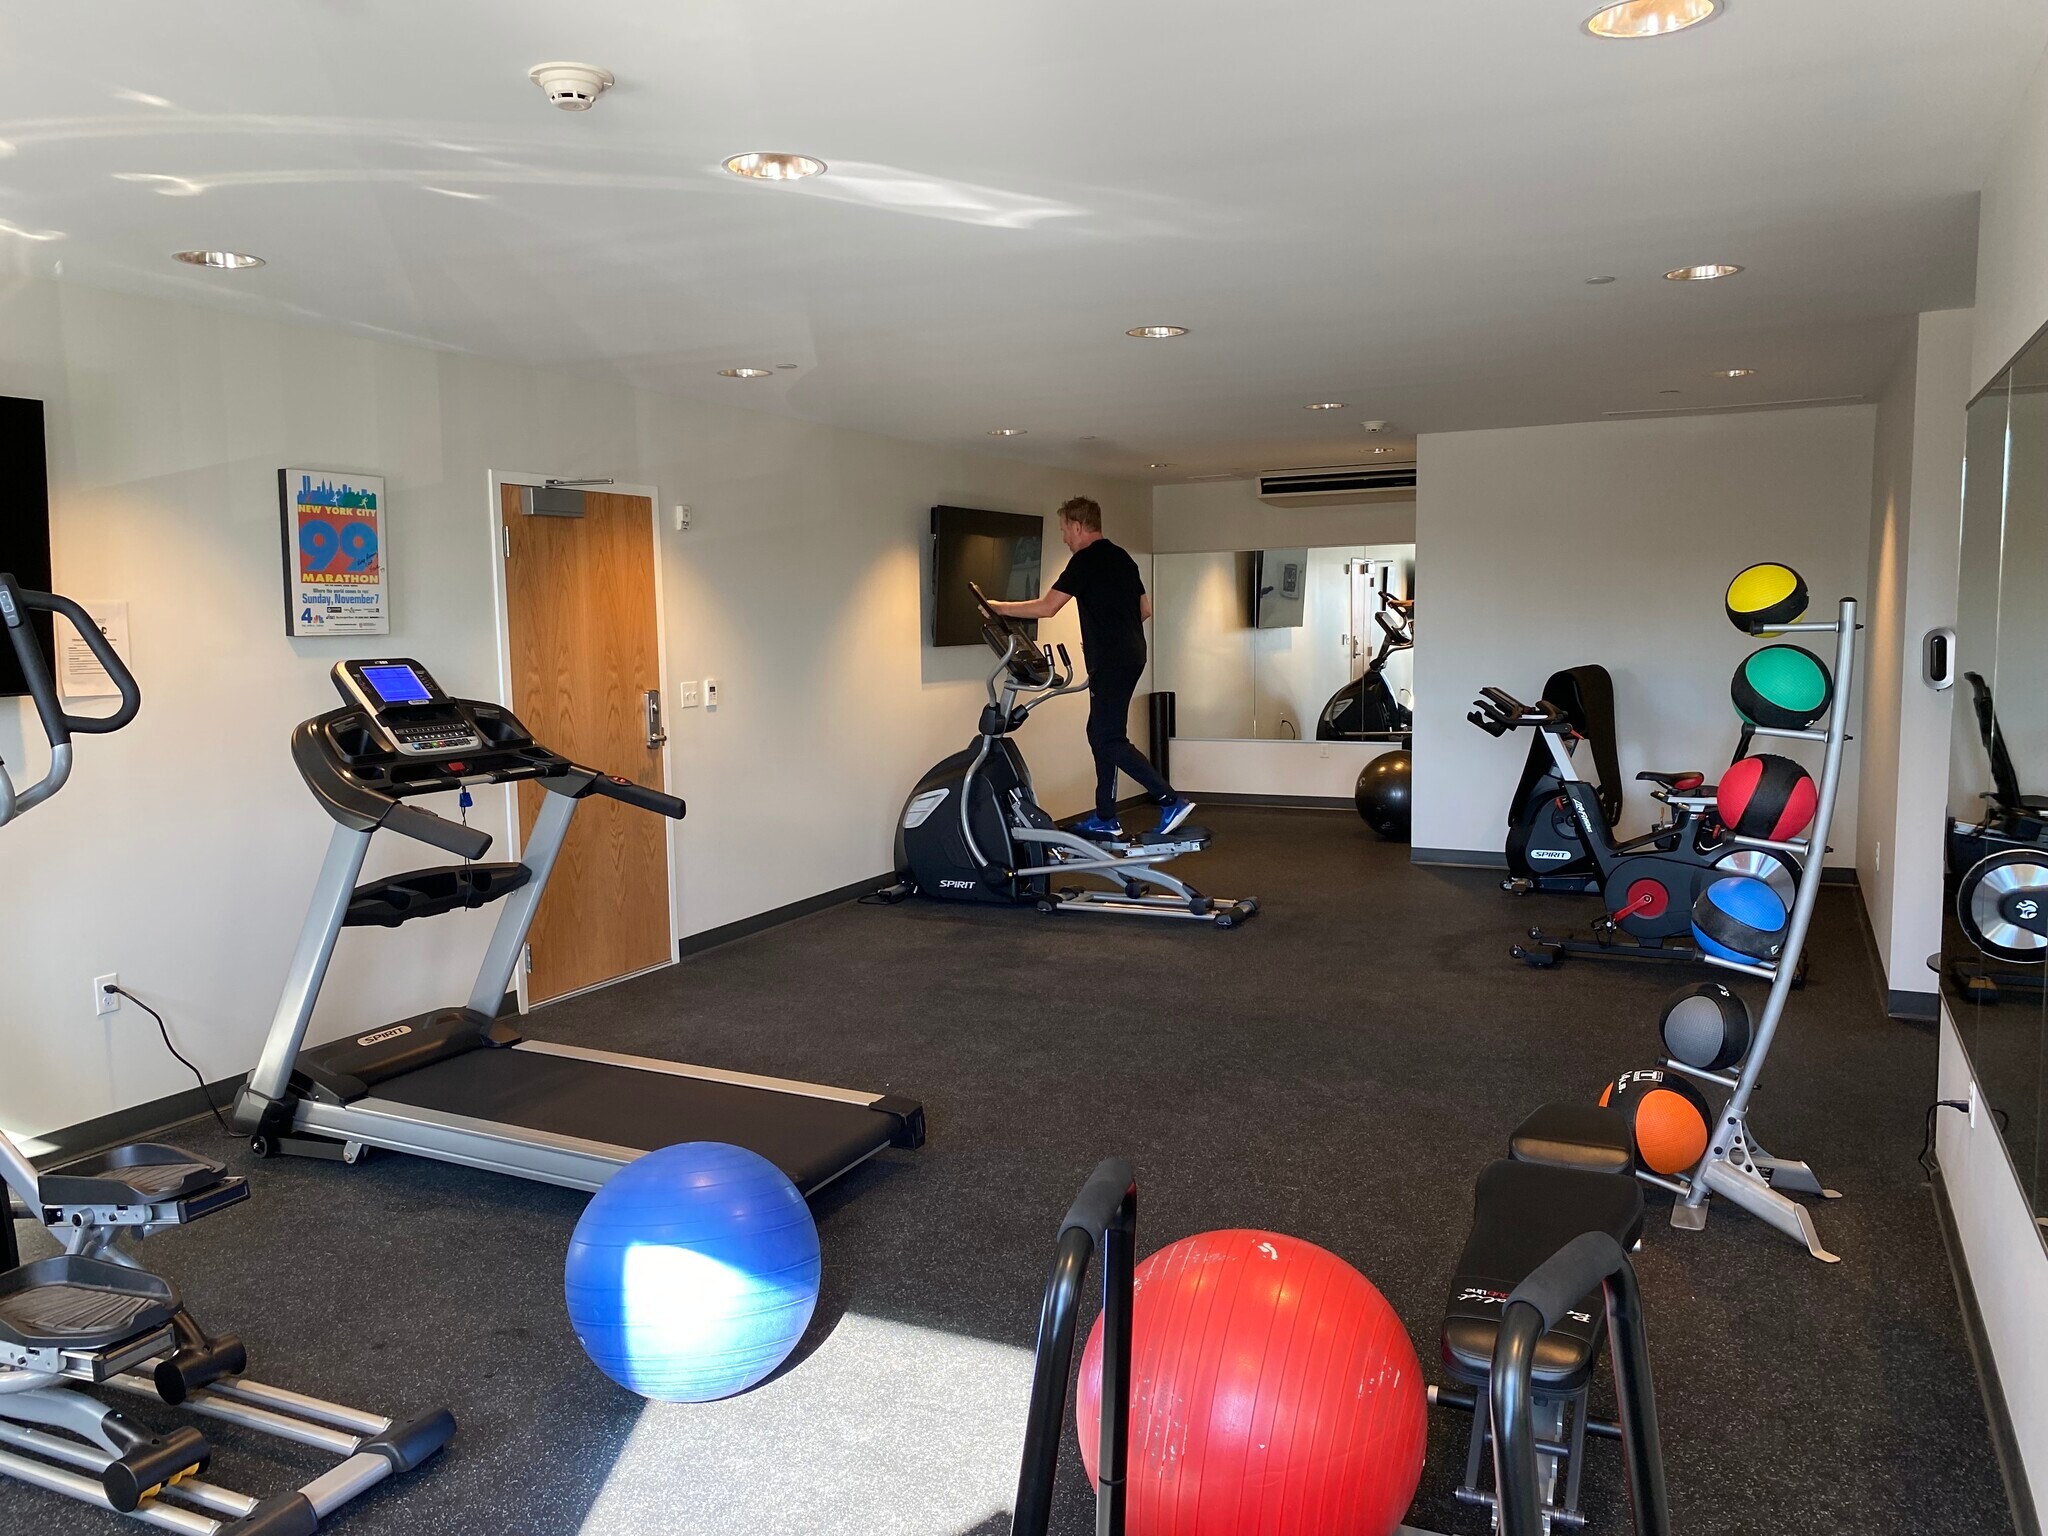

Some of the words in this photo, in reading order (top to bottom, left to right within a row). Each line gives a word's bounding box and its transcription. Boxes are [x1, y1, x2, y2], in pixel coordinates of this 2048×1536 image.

[298, 504, 321, 514] NEW
[325, 506, 353, 516] YORK
[356, 508, 376, 517] CITY
[299, 519, 378, 573] 99
[302, 573, 379, 584] MARATHON
[302, 593, 333, 606] Sunday,
[335, 593, 374, 605] November
[375, 594, 380, 605] 7
[301, 607, 313, 624] 4
[939, 880, 976, 889] SPIRIT
[364, 1028, 404, 1043] SPIRIT
